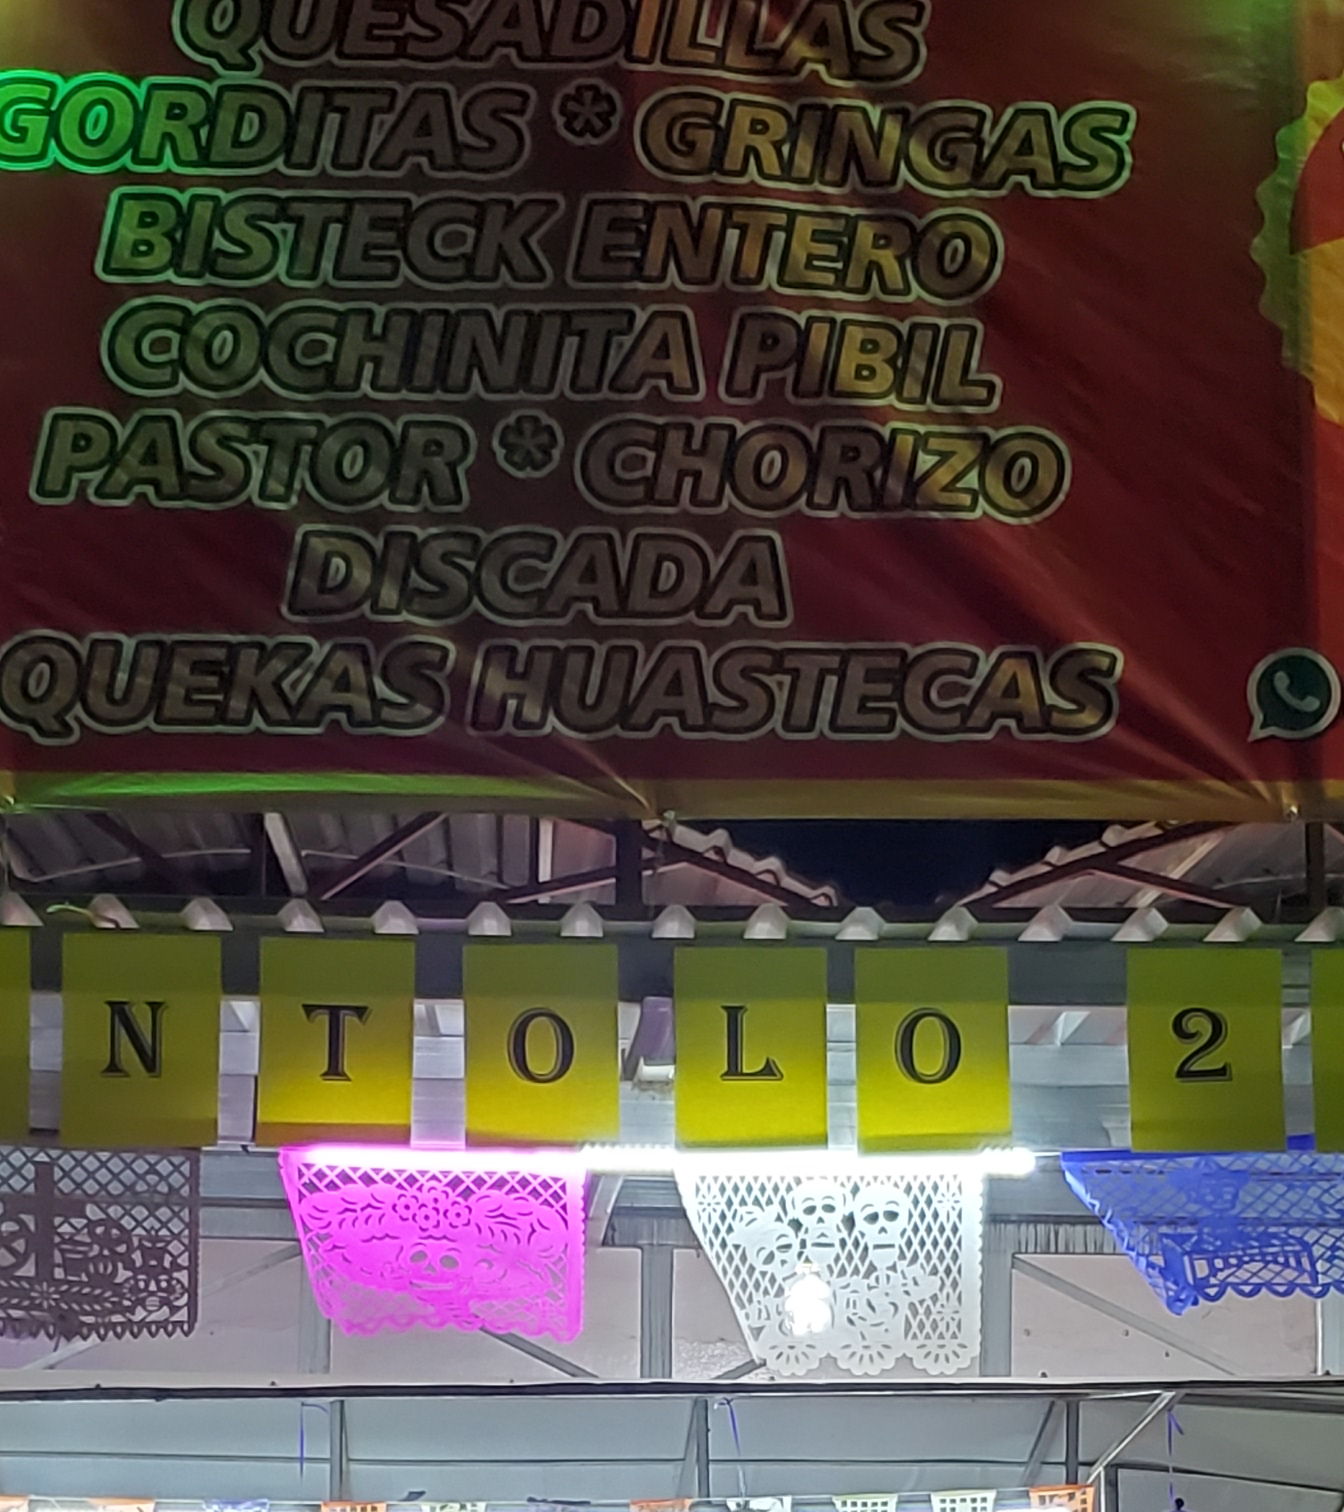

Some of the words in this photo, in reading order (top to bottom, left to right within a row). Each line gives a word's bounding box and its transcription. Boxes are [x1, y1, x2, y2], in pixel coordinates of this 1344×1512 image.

[176, 0, 924, 83] QUESADILLAS
[638, 89, 1133, 194] GRINGAS
[97, 189, 560, 286] BISTECK
[568, 196, 1001, 300] ENTERO
[103, 298, 702, 399] COCHINITA
[721, 310, 999, 409] PIBIL
[32, 409, 473, 509] PASTOR
[577, 416, 1068, 520] CHORIZO
[285, 527, 790, 625] DISCADA
[468, 640, 1121, 739] HUASTECAS
